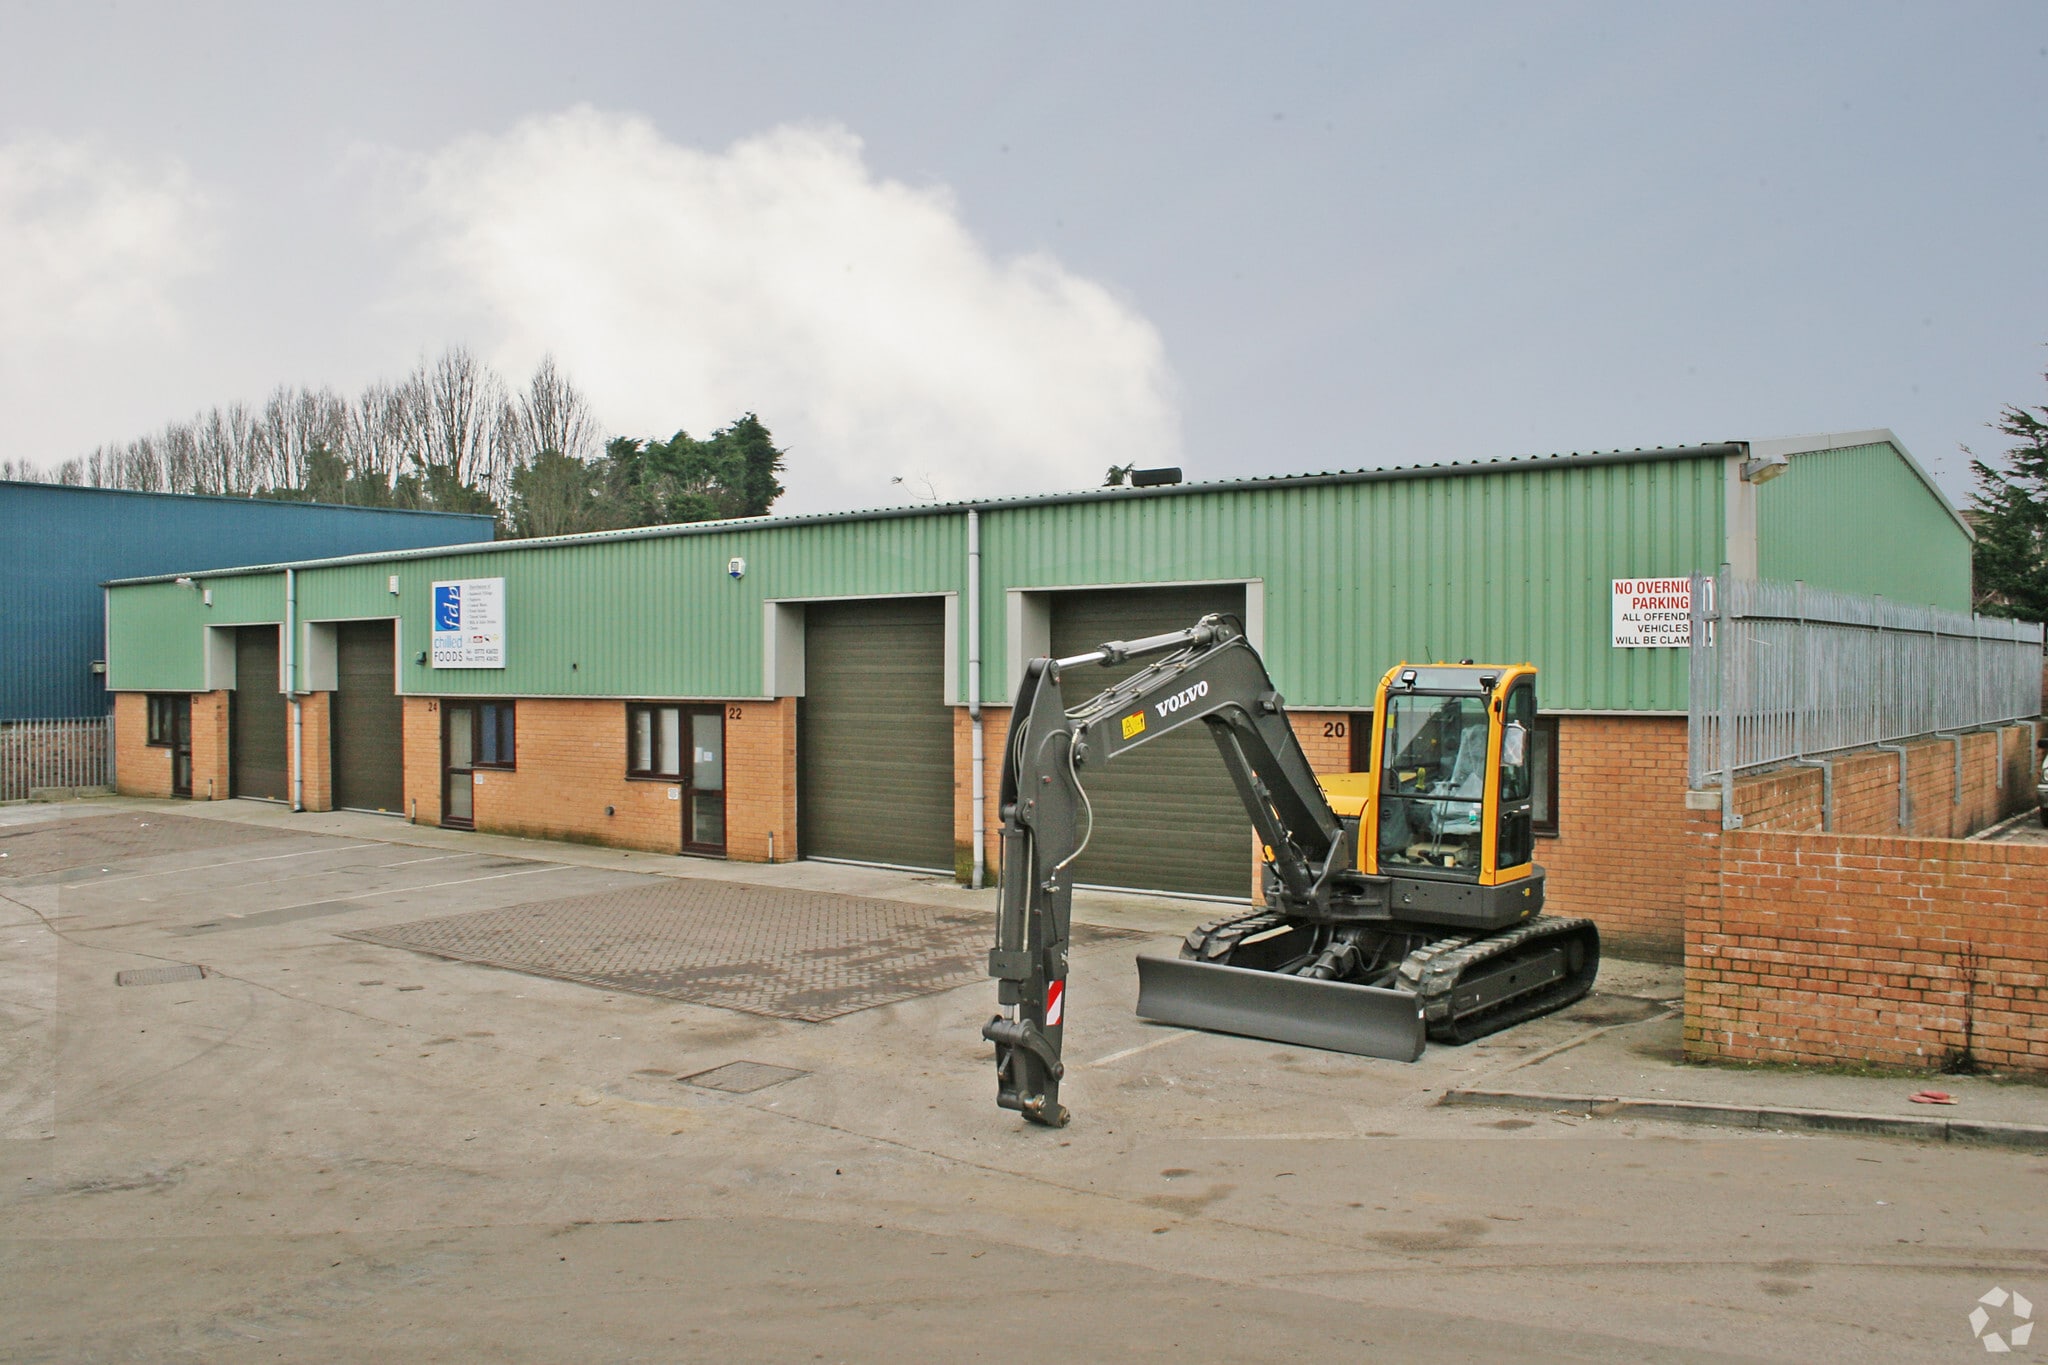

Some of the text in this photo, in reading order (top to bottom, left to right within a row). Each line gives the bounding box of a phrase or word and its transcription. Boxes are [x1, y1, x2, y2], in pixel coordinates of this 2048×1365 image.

[1615, 580, 1690, 595] NO OVERNI
[1632, 596, 1689, 609] PARKING
[1622, 612, 1690, 622] ALL OFFEND
[1637, 624, 1689, 633] VEHICLES
[434, 635, 463, 648] chilled
[1615, 635, 1690, 645] WILL BE CLAM
[434, 650, 464, 662] FOODS
[1155, 680, 1209, 718] VOLVO
[728, 707, 742, 720] 22
[1323, 721, 1345, 738] 20
